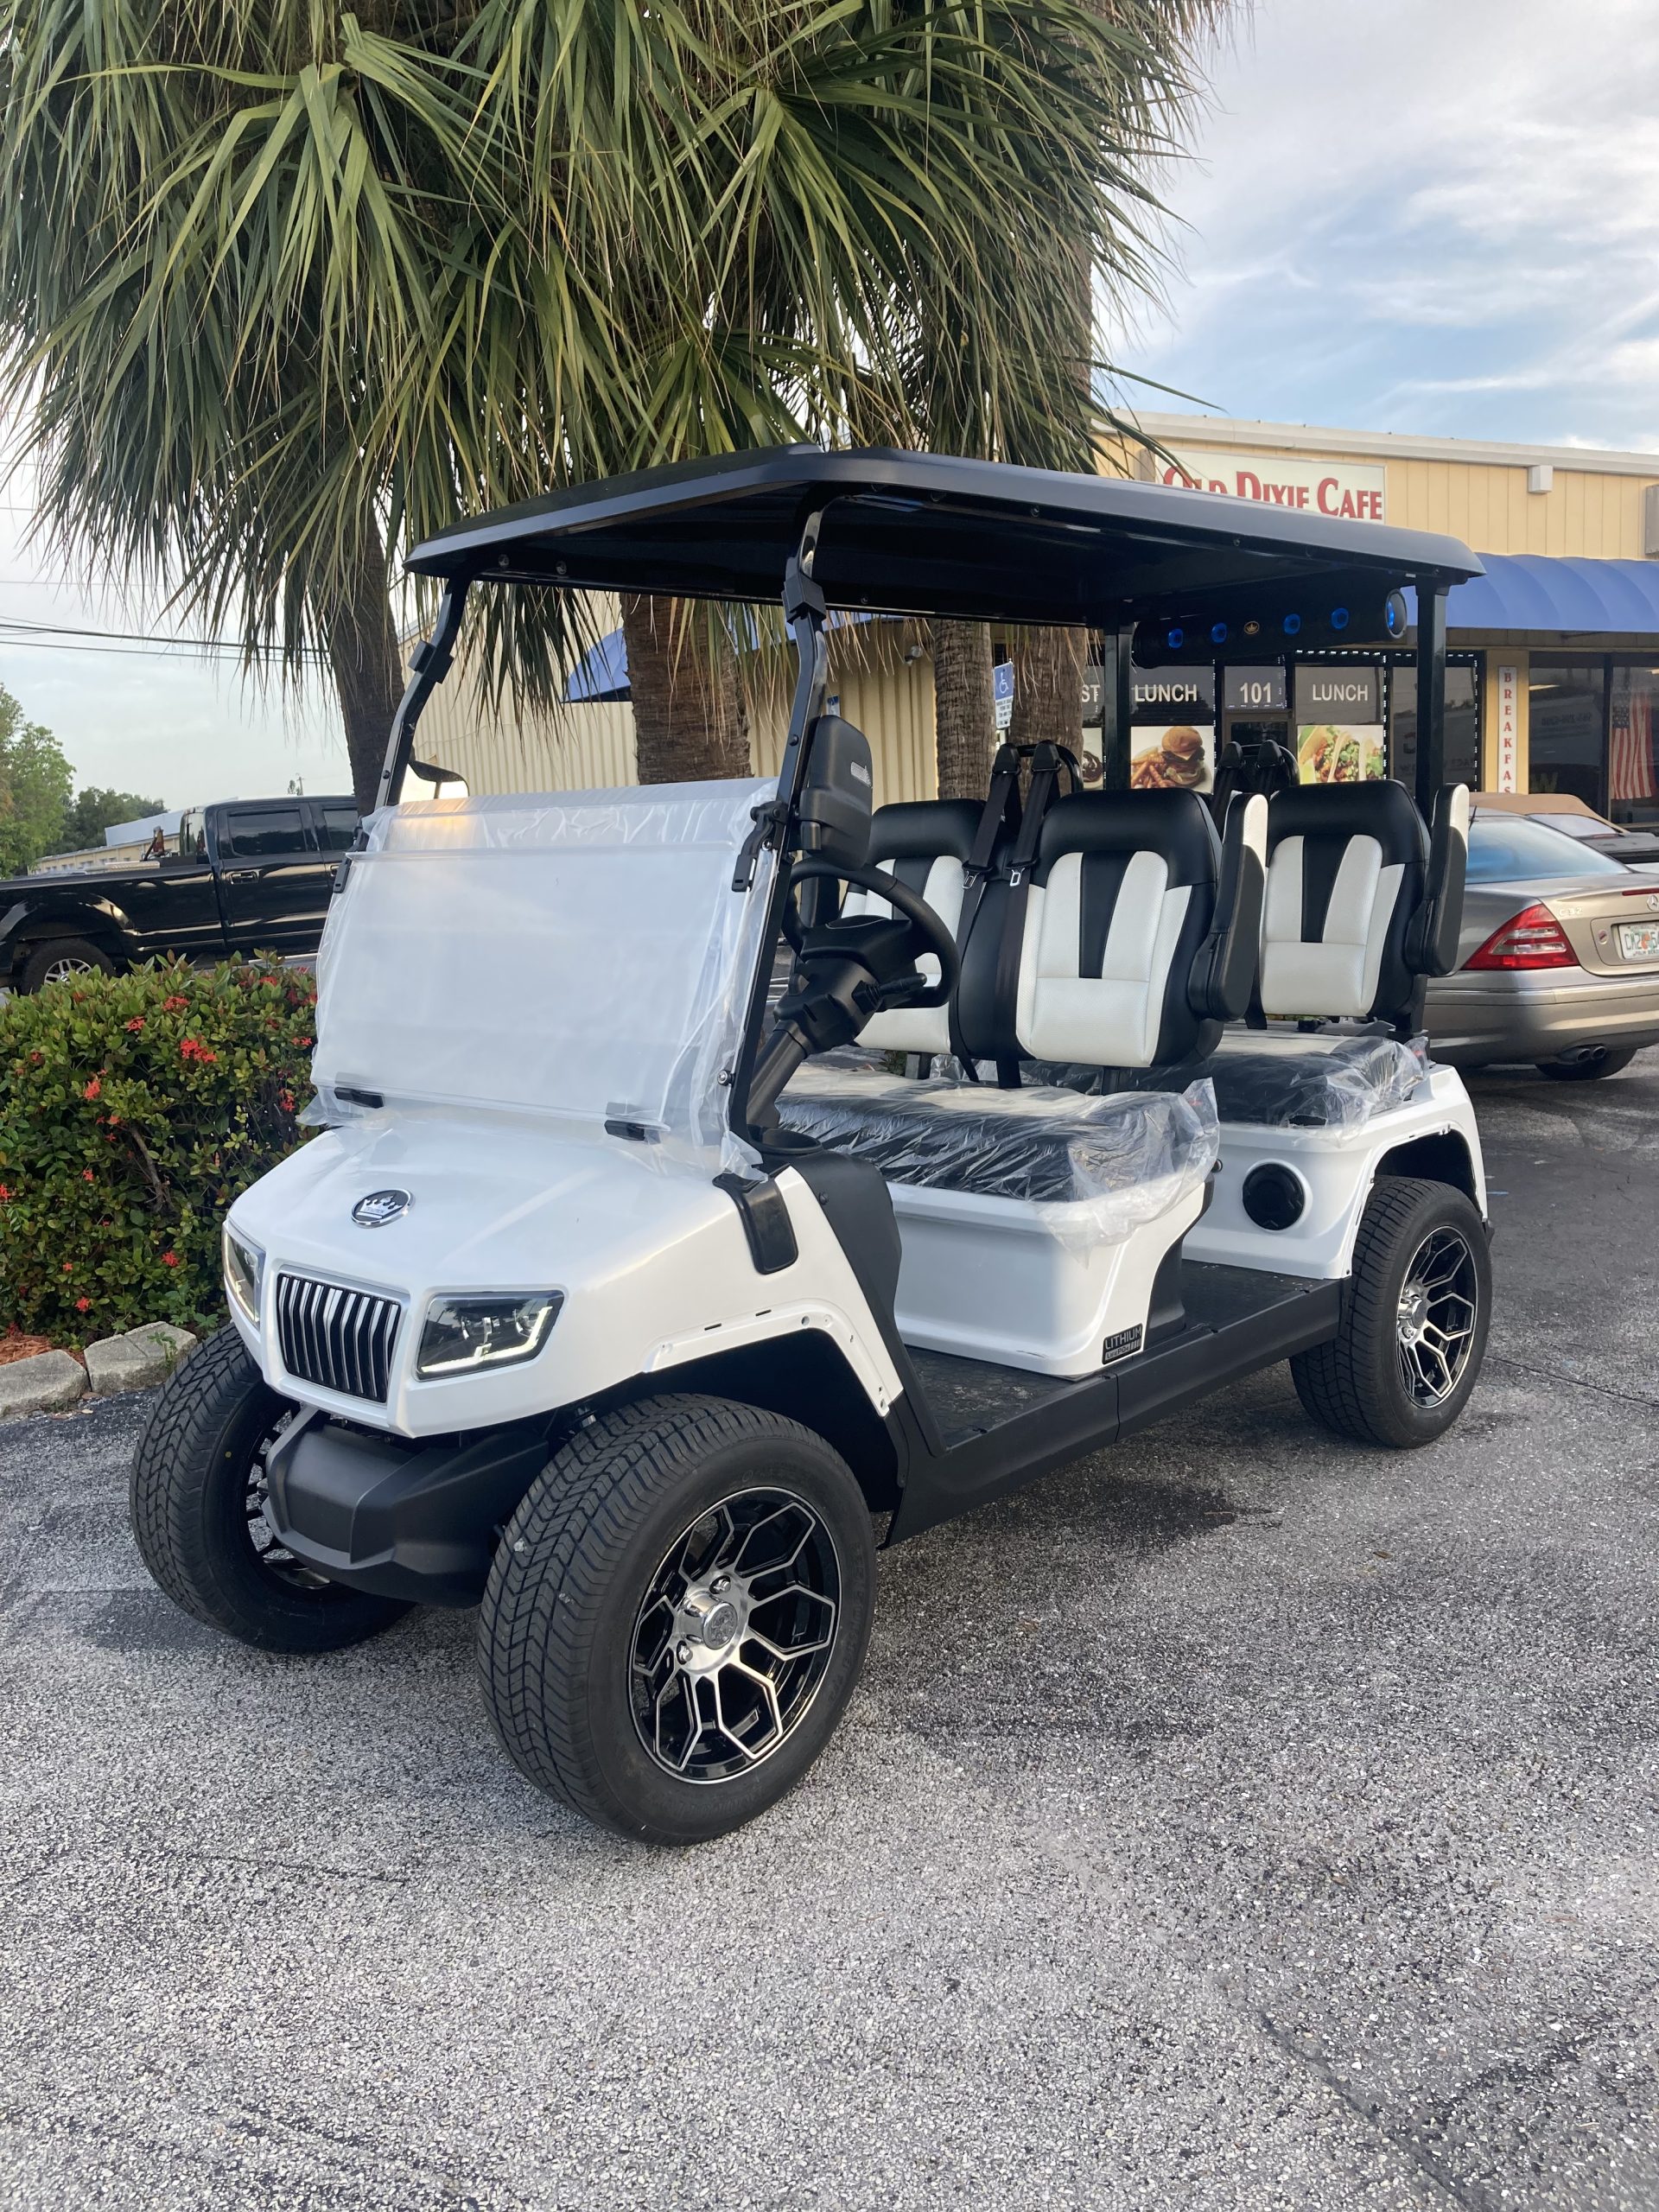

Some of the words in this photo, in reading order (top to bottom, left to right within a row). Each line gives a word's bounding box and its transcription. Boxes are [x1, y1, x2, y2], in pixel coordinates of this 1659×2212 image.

[1236, 471, 1309, 509] DIXIE
[1317, 478, 1382, 519] CAFE
[1135, 683, 1198, 702] LUNCH
[1240, 682, 1271, 703] 101
[1313, 683, 1369, 702] LUNCH
[1105, 1326, 1141, 1350] LITHIUM
